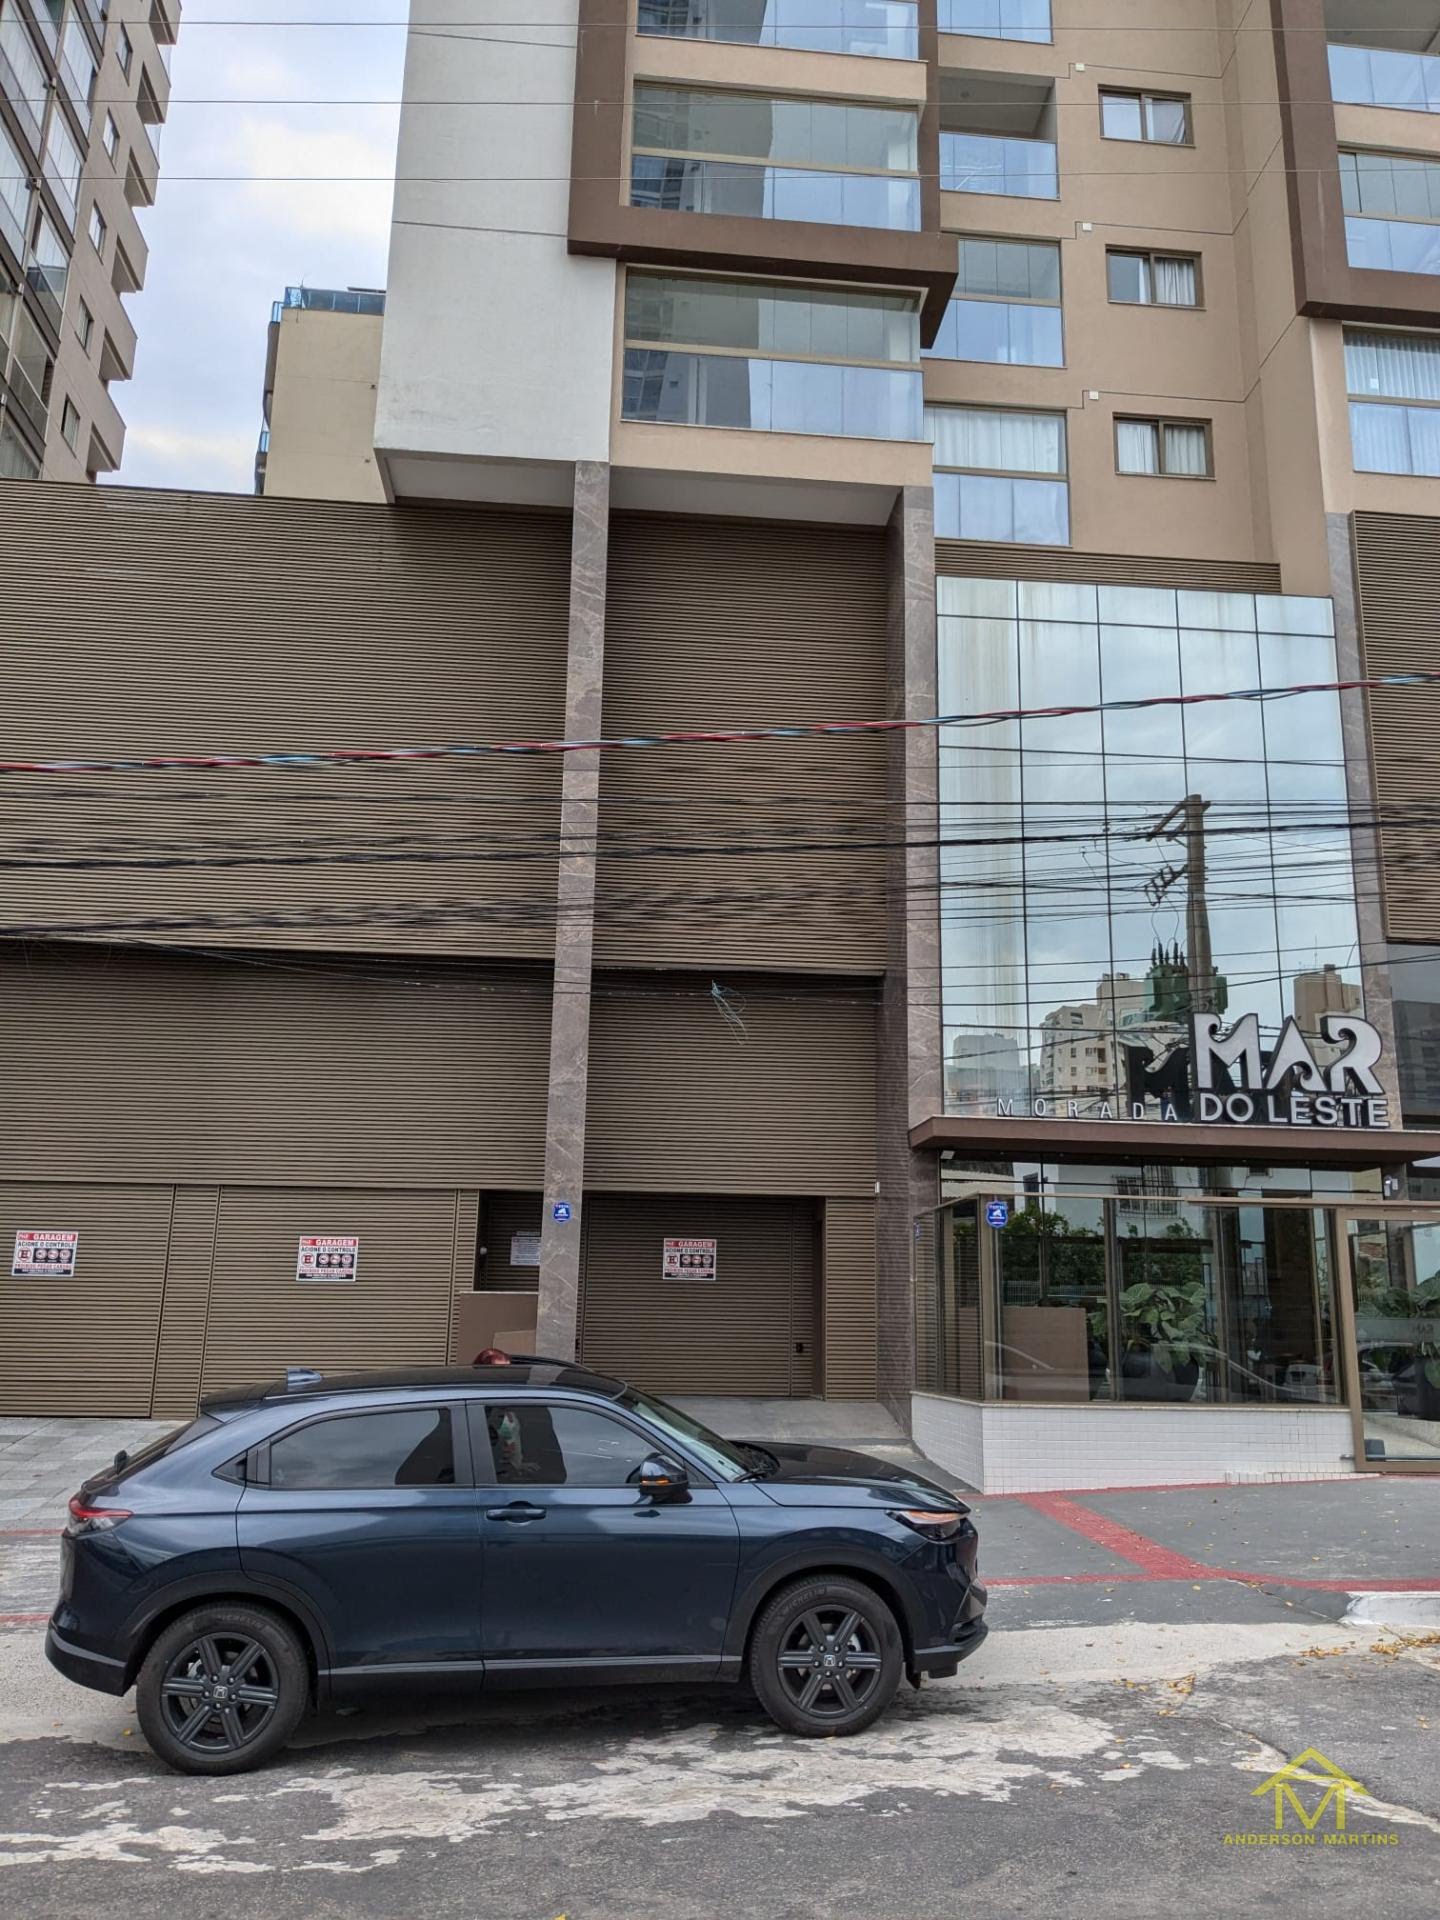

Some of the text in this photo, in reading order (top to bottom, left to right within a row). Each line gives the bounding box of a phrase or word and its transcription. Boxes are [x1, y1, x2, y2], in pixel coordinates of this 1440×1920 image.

[1192, 1012, 1385, 1096] MAR
[997, 1098, 1178, 1121] MORADA
[1200, 1092, 1391, 1128] DO LESTE
[33, 1233, 73, 1241] GARAGEM
